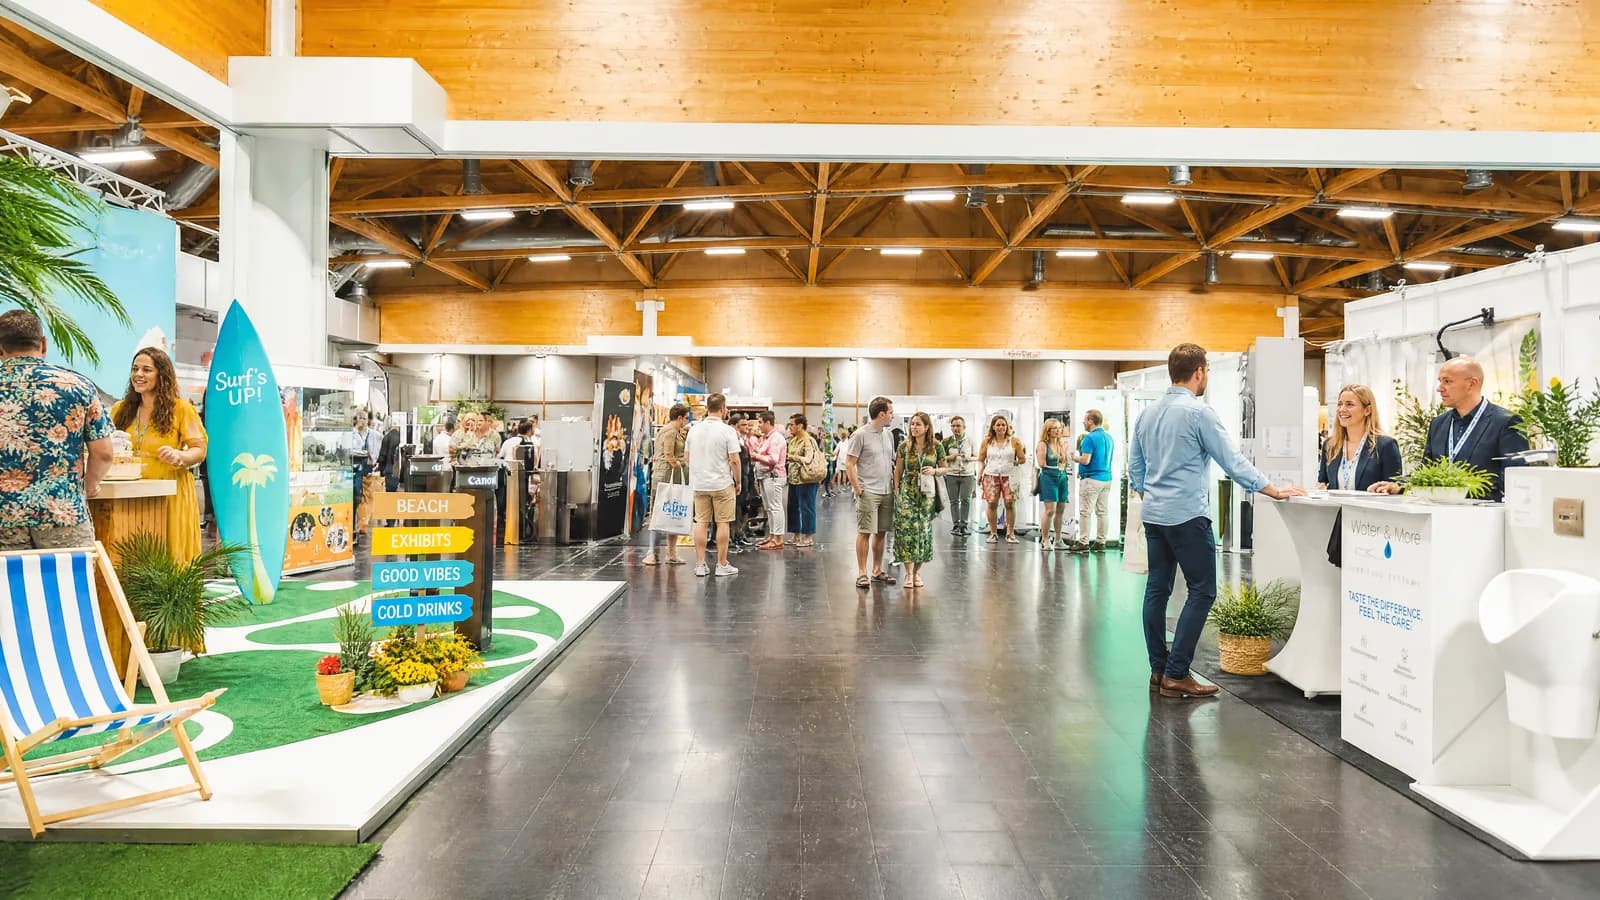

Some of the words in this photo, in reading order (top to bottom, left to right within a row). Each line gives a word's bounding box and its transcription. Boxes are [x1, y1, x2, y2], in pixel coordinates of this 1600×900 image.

[215, 367, 268, 391] Surf's
[228, 386, 262, 406] UP!
[397, 499, 449, 513] BEACH
[391, 533, 451, 548] EXHIBITS
[1383, 524, 1392, 540] &
[1394, 527, 1422, 546] More
[380, 568, 419, 583] GOOD
[423, 566, 461, 582] VIBES
[1348, 590, 1366, 605] TASTE
[1367, 595, 1380, 608] THE
[377, 603, 413, 620] COLD
[417, 601, 463, 617] DRINKS
[1359, 605, 1375, 620] FEEL
[1376, 610, 1391, 625] THE
